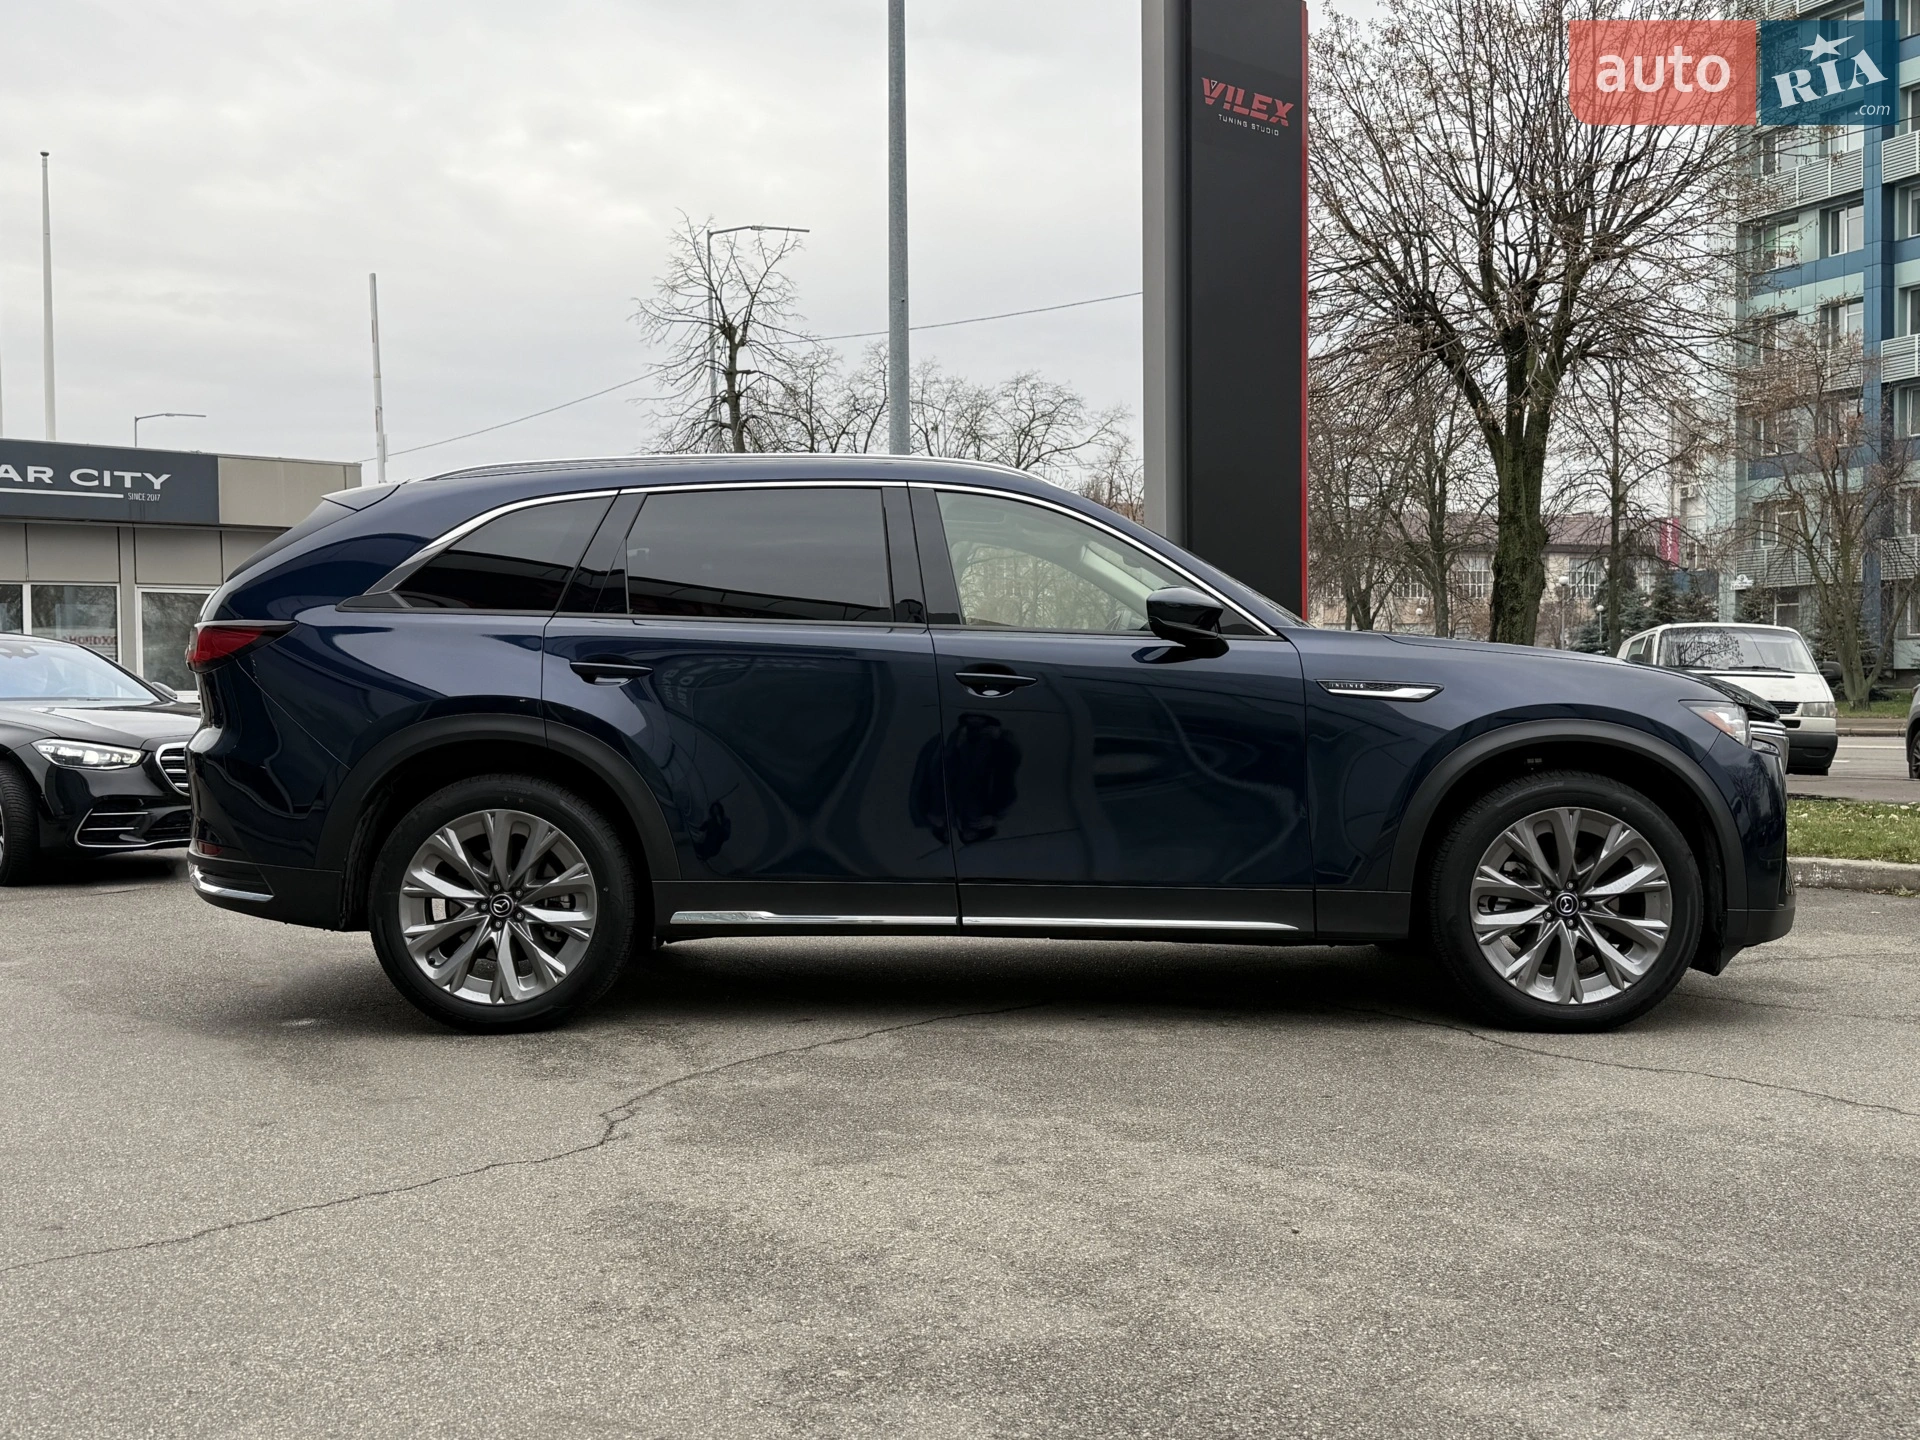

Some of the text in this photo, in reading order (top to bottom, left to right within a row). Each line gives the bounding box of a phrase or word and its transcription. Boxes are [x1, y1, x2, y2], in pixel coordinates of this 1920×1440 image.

[1201, 77, 1295, 127] VILEX
[1218, 113, 1279, 136] TUNING STUDIO
[69, 468, 172, 490] CITY
[127, 492, 161, 502] SINCE 2017
